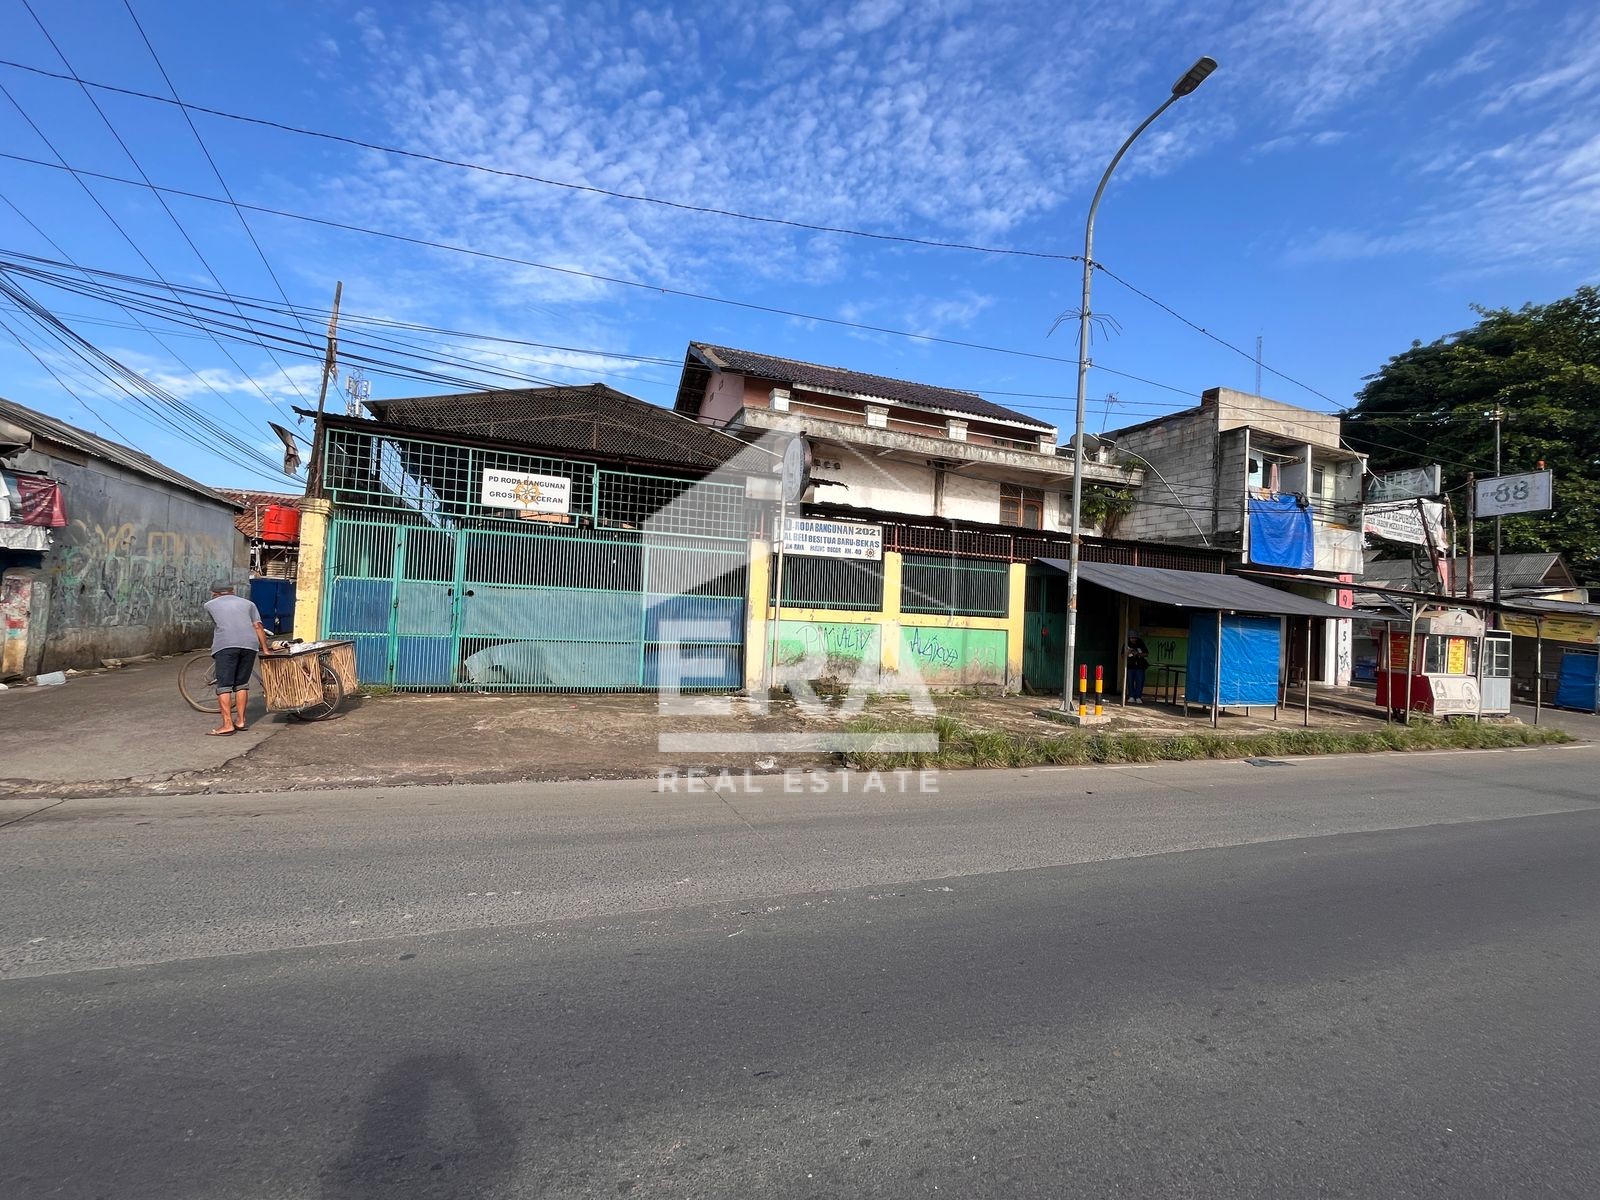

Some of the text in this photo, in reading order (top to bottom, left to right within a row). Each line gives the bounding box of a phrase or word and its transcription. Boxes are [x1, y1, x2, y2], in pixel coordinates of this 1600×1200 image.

[524, 480, 566, 490] BANGUNAN
[490, 491, 520, 500] GROSIR
[531, 496, 563, 504] ECERAN
[795, 521, 815, 532] RODA
[815, 522, 855, 536] BANGUNAN
[855, 527, 881, 537] 2021
[808, 534, 823, 544] BESI
[823, 536, 837, 545] TUA
[856, 538, 880, 549] BEKAS
